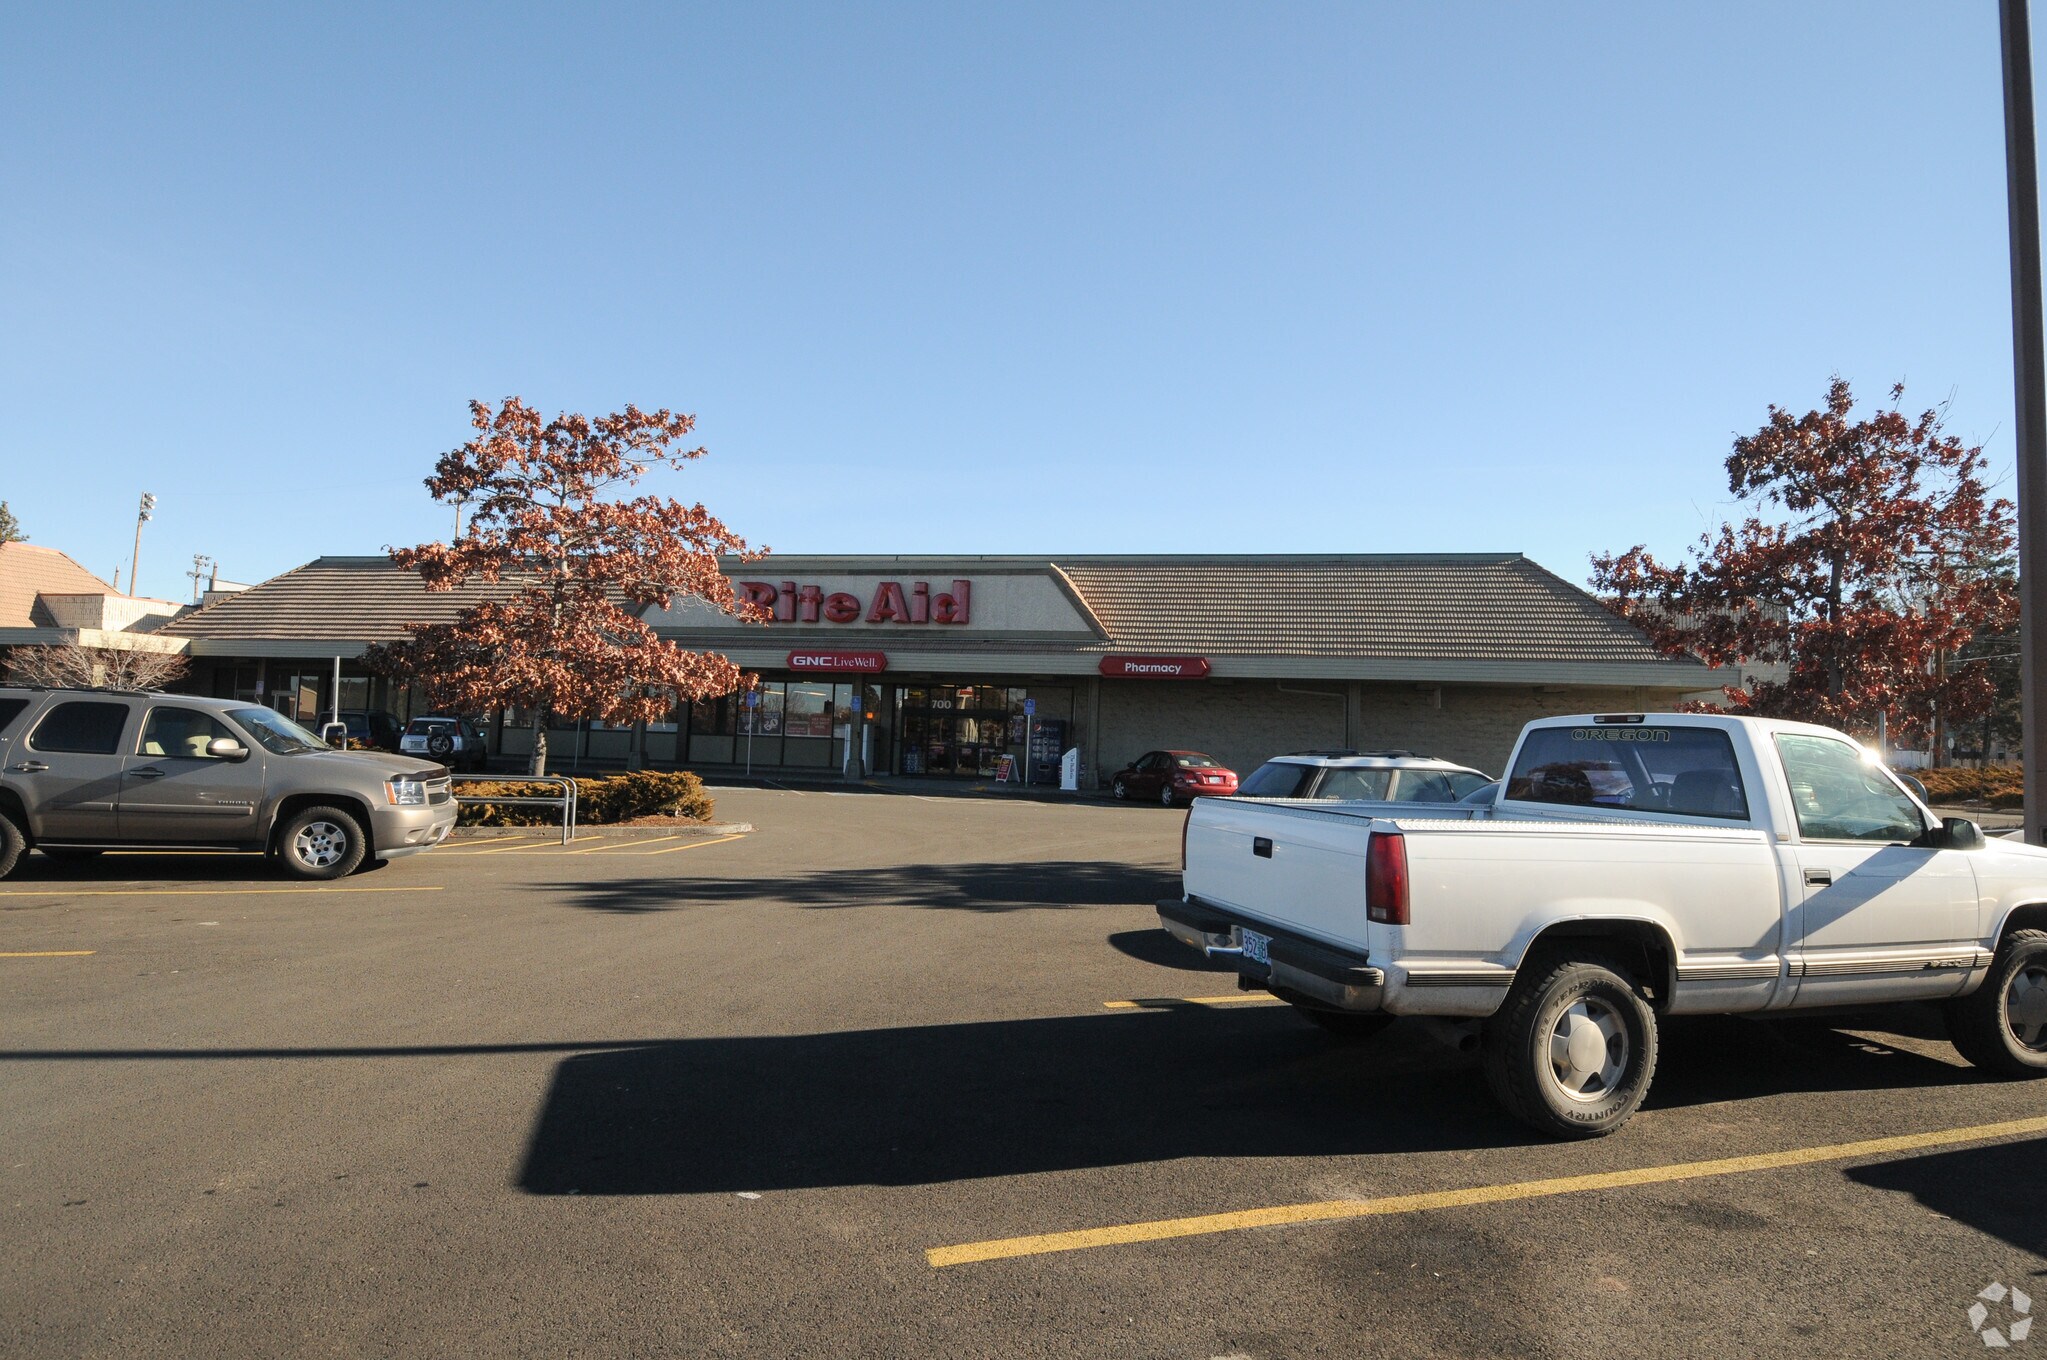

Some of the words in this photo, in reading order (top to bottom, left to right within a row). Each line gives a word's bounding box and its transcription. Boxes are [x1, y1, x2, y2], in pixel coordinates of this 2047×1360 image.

[739, 581, 861, 623] Rite
[865, 579, 971, 624] Aid
[793, 656, 832, 666] GNC
[1124, 662, 1182, 674] Pharmacy
[931, 700, 952, 709] 700
[1571, 728, 1670, 742] OREGON
[1538, 1016, 1552, 1047] ALL
[1552, 980, 1614, 1008] TERRAIN
[1565, 1093, 1629, 1121] COUNTRY
